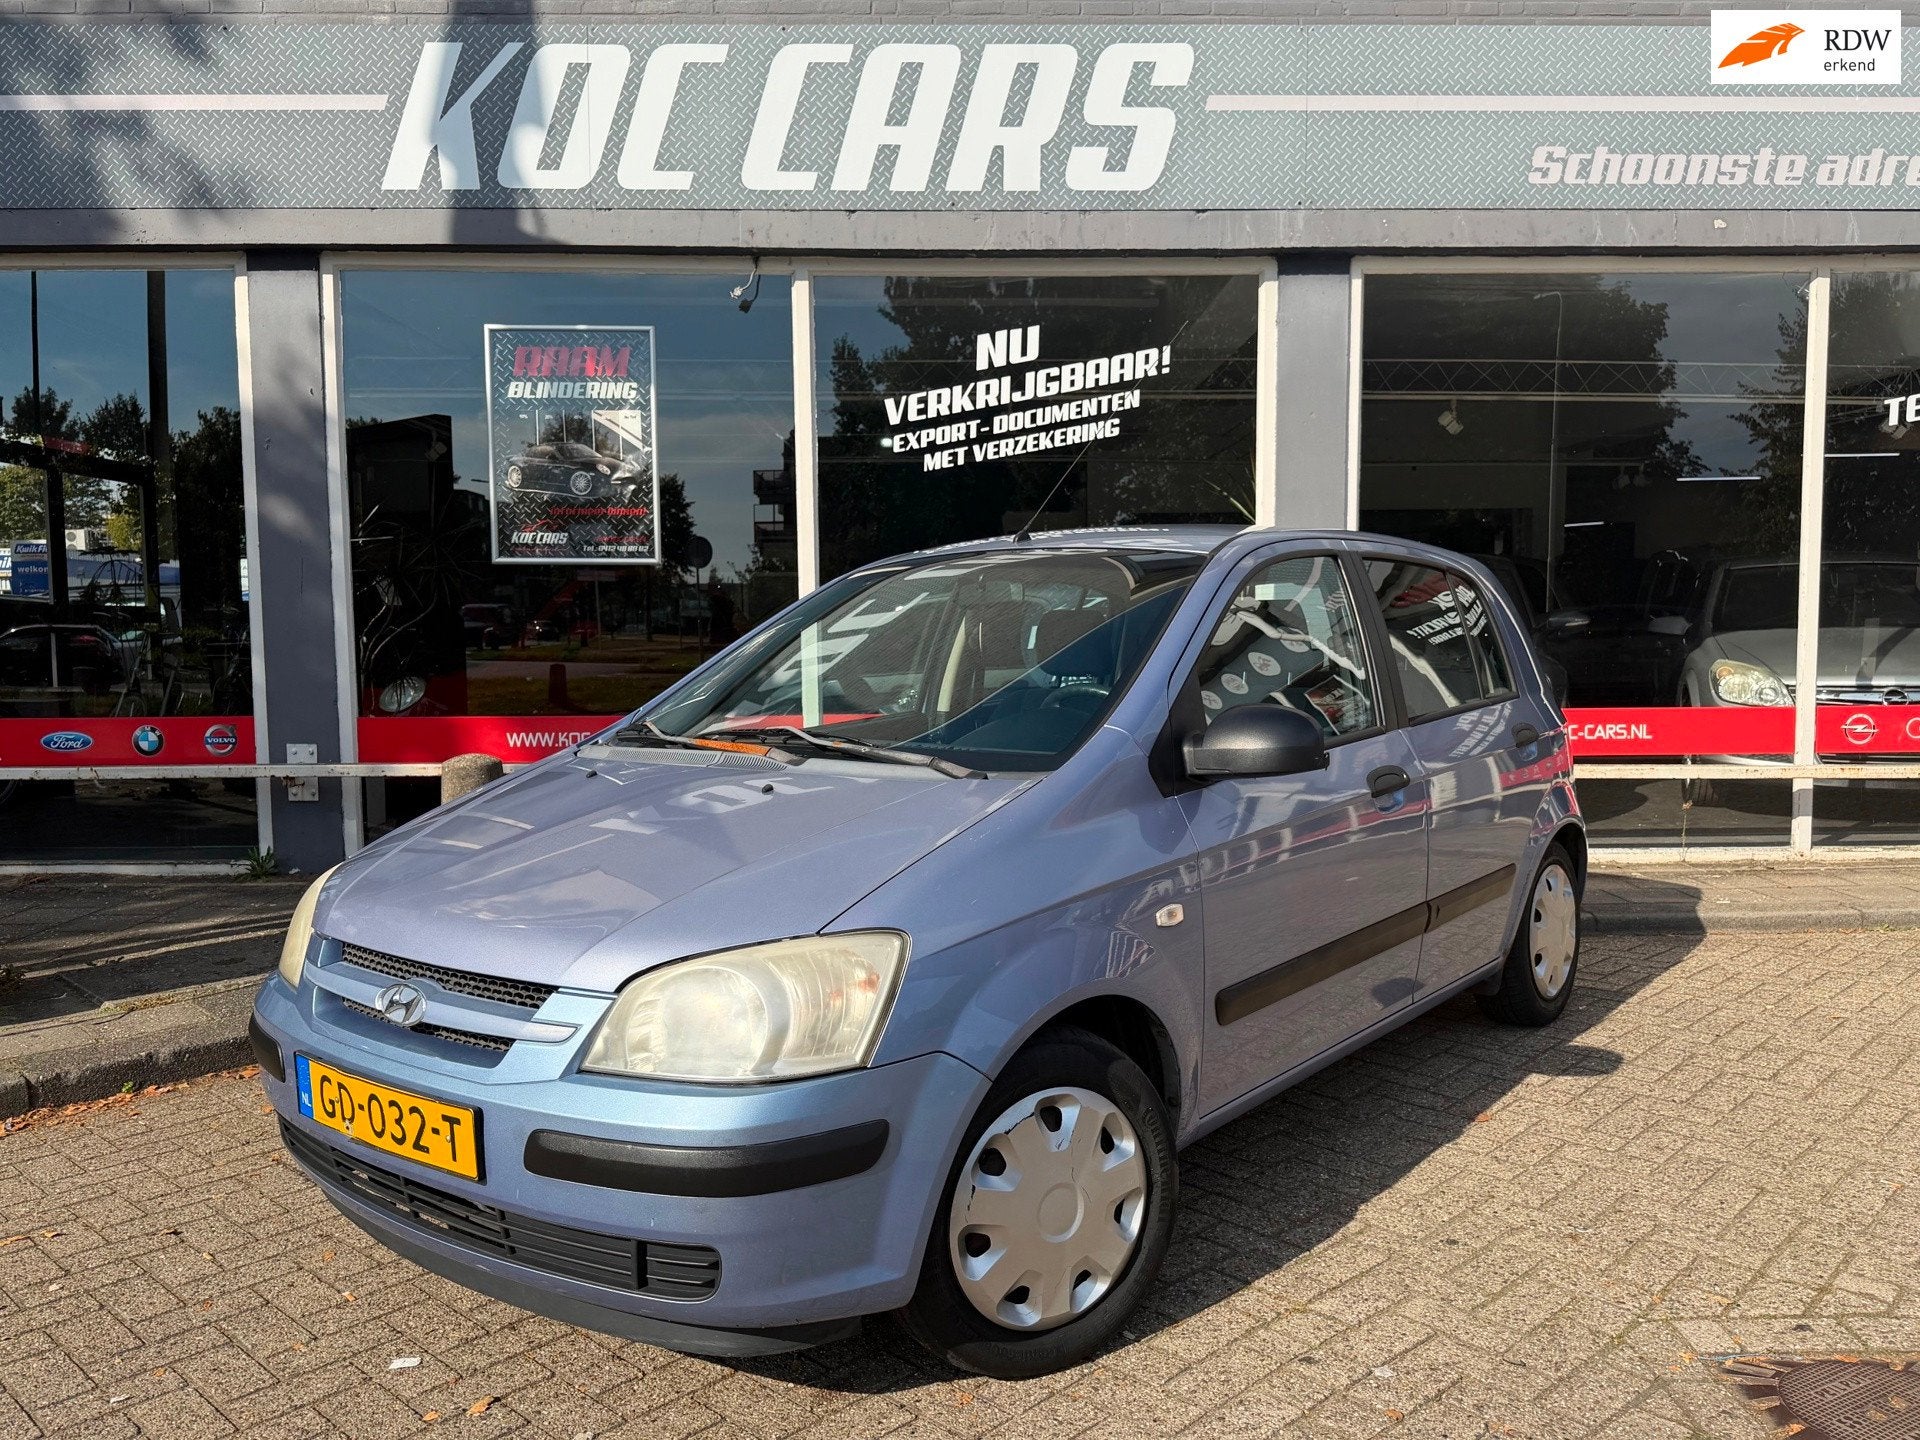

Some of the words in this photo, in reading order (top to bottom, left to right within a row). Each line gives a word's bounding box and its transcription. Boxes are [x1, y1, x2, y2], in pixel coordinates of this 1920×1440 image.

[381, 42, 728, 190] KOC
[742, 42, 1194, 191] CARS
[1528, 146, 1807, 185] Schoonste
[512, 347, 632, 377] RAAM
[976, 325, 1040, 371] NU
[508, 381, 637, 399] BLINDERING
[884, 345, 1171, 425] VERKRIJGBAAR!
[892, 418, 989, 453] EXPORT-
[992, 389, 1140, 435] DOCUMENTEN
[923, 446, 968, 473] MET
[973, 418, 1120, 463] VERZEKERING
[16, 545, 37, 553] Kwik
[511, 532, 536, 545] KOC
[536, 532, 568, 544] CARS
[50, 734, 84, 748] Ford
[135, 726, 162, 736] BMW
[301, 1091, 312, 1108] NL
[319, 1074, 461, 1163] GD-032-T
